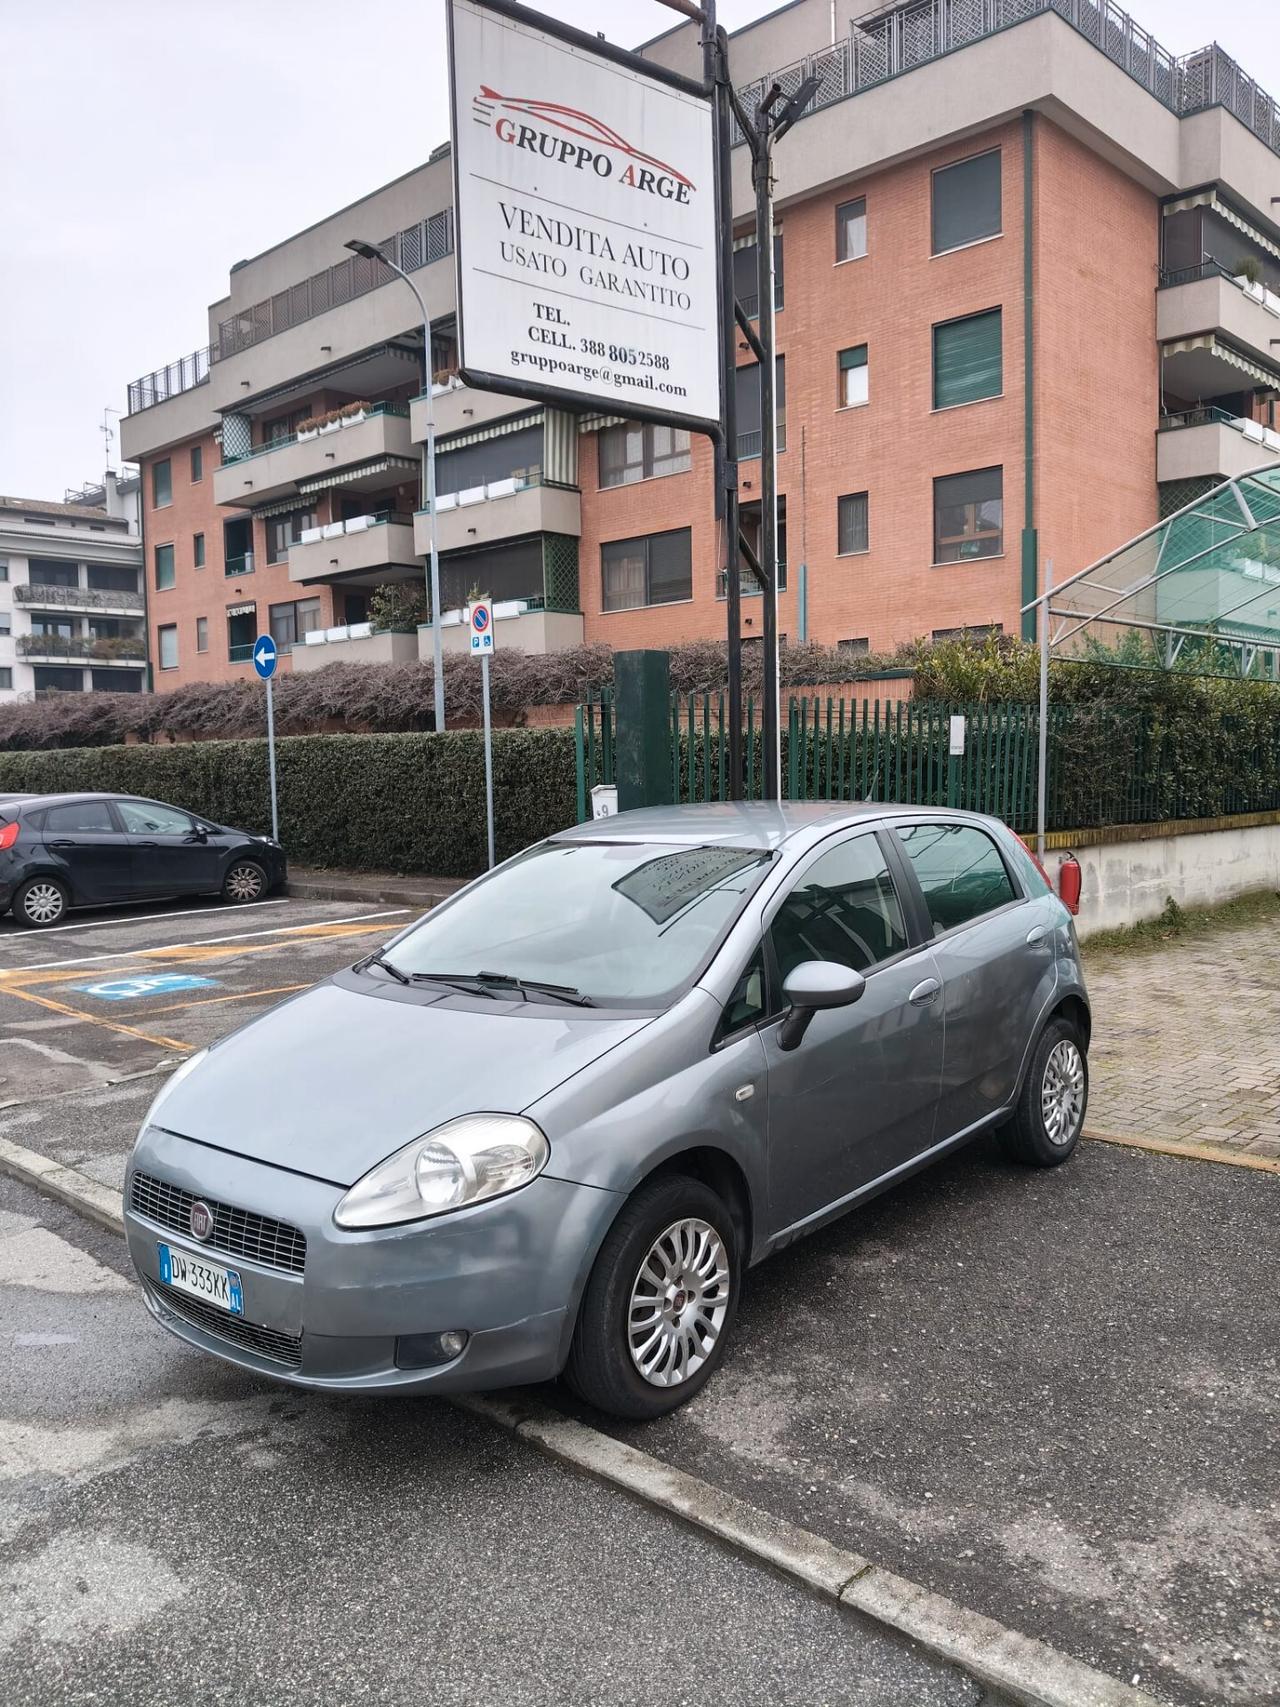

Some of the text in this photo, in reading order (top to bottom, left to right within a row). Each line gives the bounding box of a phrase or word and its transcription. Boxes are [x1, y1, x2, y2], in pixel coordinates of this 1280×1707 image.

[495, 118, 690, 205] GRUPPO ARGE
[498, 201, 689, 281] VENDITA AUTO
[500, 241, 691, 310] USATO GARANTITO
[528, 325, 576, 350] CELL.
[580, 338, 606, 357] 388
[533, 302, 571, 326] TEL.
[511, 350, 687, 397] gruppoarge@gmail.com
